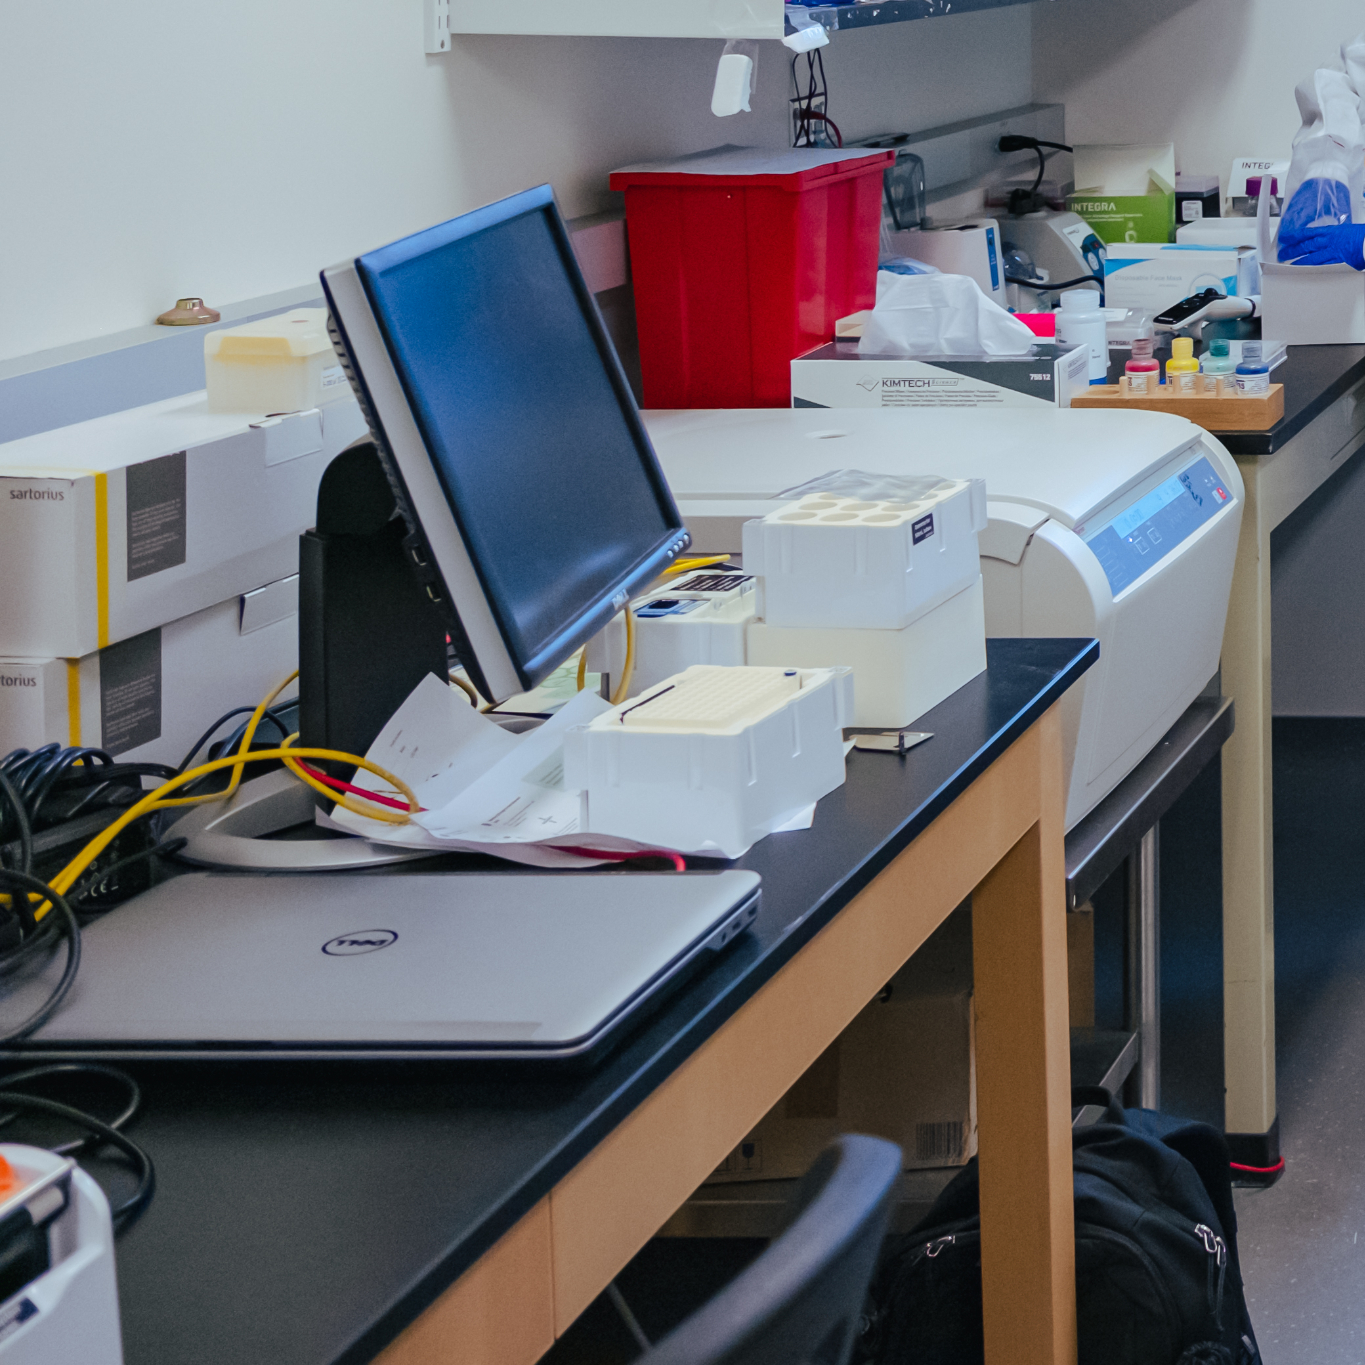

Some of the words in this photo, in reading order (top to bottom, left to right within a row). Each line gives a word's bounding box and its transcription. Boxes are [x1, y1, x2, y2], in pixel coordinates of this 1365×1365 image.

[1242, 162, 1273, 170] INTEG
[1071, 202, 1117, 212] INTEGRA
[881, 379, 931, 388] KIMTECH
[10, 487, 65, 501] sartorius
